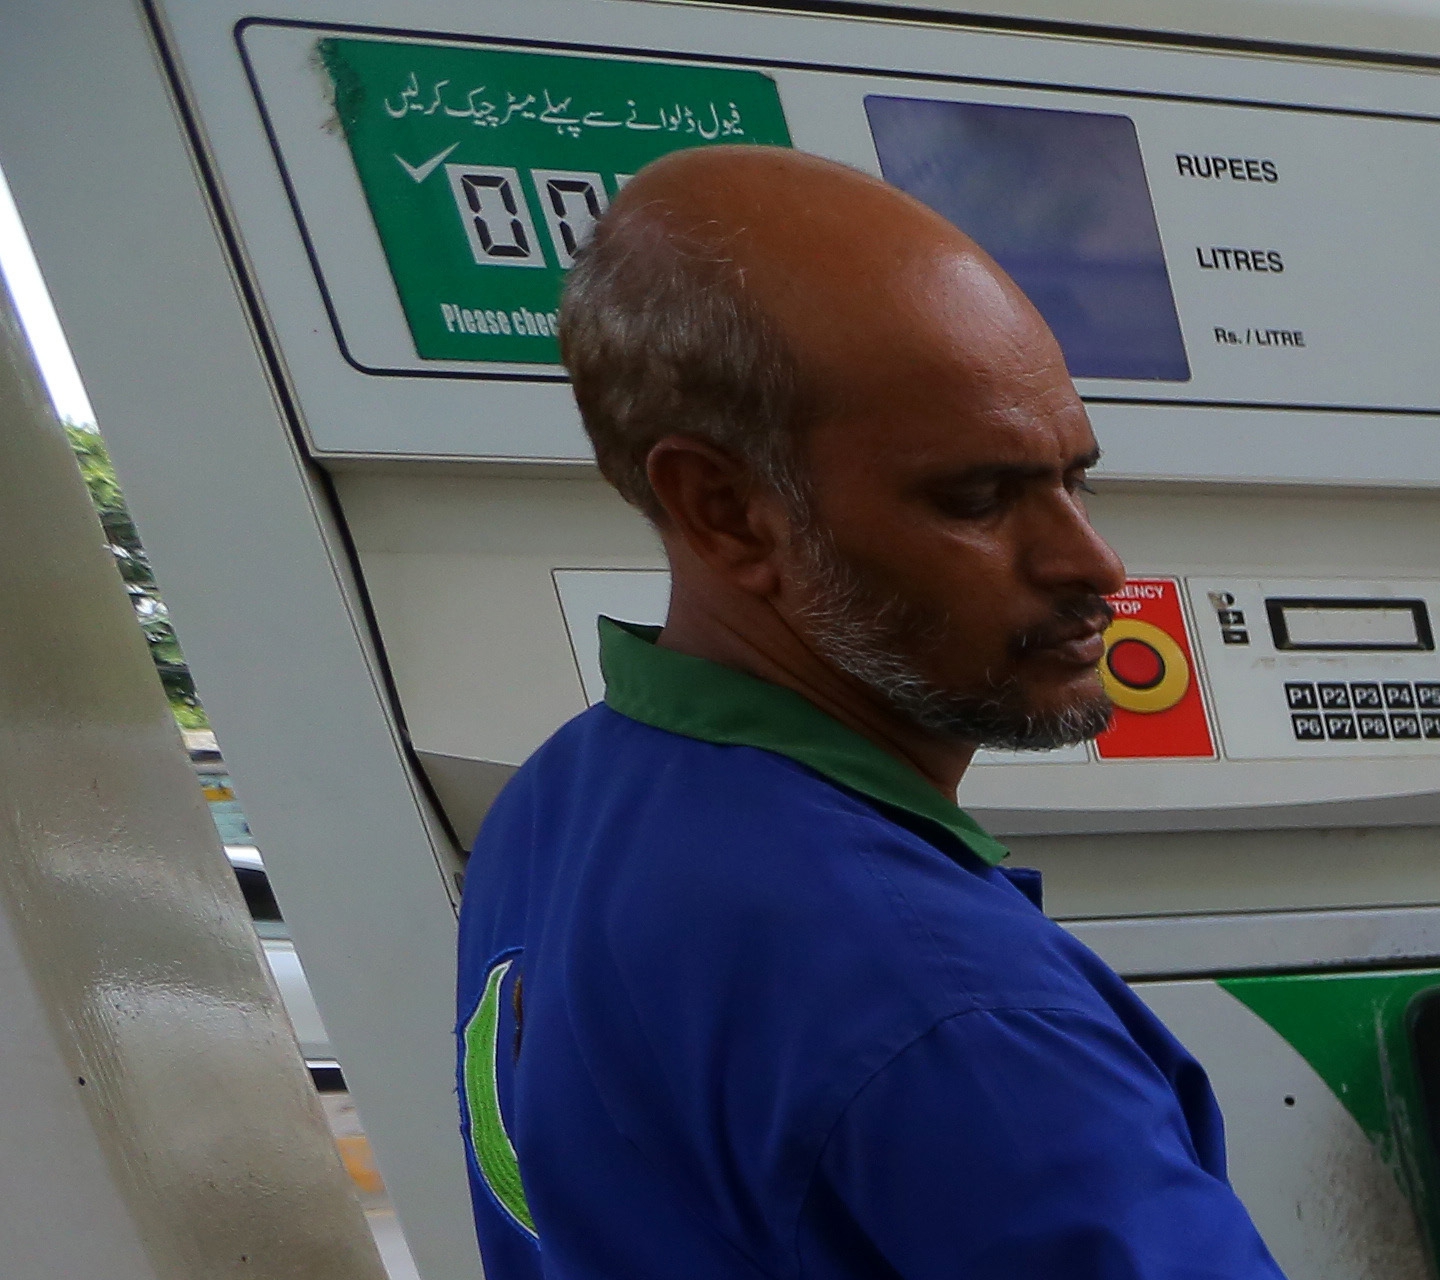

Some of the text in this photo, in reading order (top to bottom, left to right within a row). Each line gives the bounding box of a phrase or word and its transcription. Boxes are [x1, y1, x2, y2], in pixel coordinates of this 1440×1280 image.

[444, 86, 500, 128] چیک
[500, 92, 536, 125] میٹر
[540, 89, 581, 139] پہلے
[582, 110, 623, 128] سے
[625, 100, 696, 134] ڈلوانے
[698, 101, 745, 140] فیول
[1176, 153, 1278, 183] RUPEES
[1196, 247, 1284, 272] LITRES
[440, 303, 512, 335] Please
[1108, 600, 1142, 614] TOP
[1289, 688, 1312, 704] P1
[1323, 687, 1347, 705] P2
[1354, 687, 1379, 705] P3
[1387, 687, 1411, 705] P4
[1296, 718, 1321, 736] P6
[1329, 718, 1352, 736] P7
[1362, 718, 1385, 736] P8
[1394, 718, 1418, 736] P9
